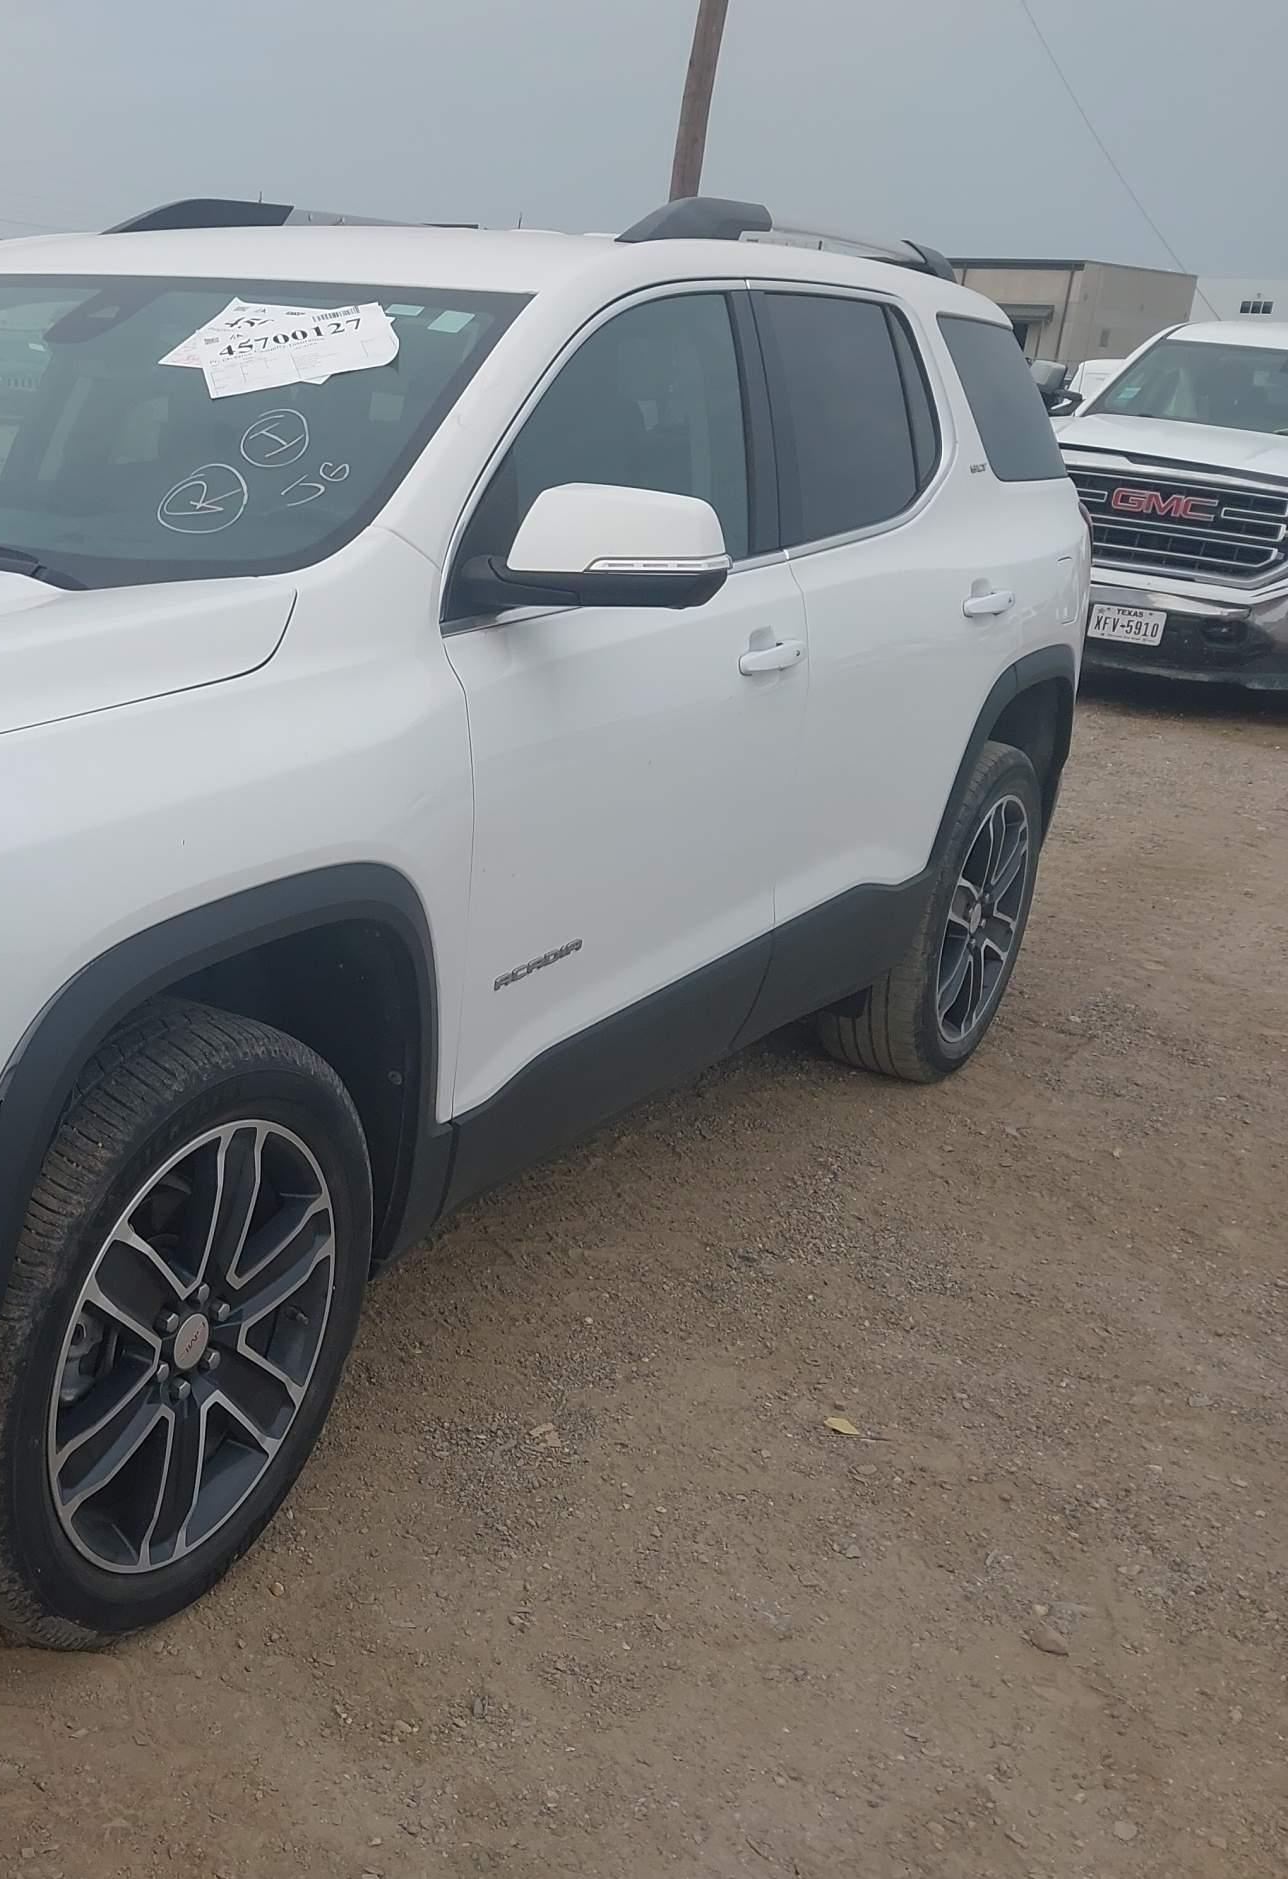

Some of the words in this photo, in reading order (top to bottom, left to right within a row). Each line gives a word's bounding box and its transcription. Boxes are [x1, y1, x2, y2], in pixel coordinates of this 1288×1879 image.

[219, 318, 361, 356] 45700127
[1112, 487, 1219, 522] GMC
[1094, 615, 1160, 638] XFV-5910
[1117, 608, 1144, 618] TEXAS
[494, 938, 582, 991] ACADIA
